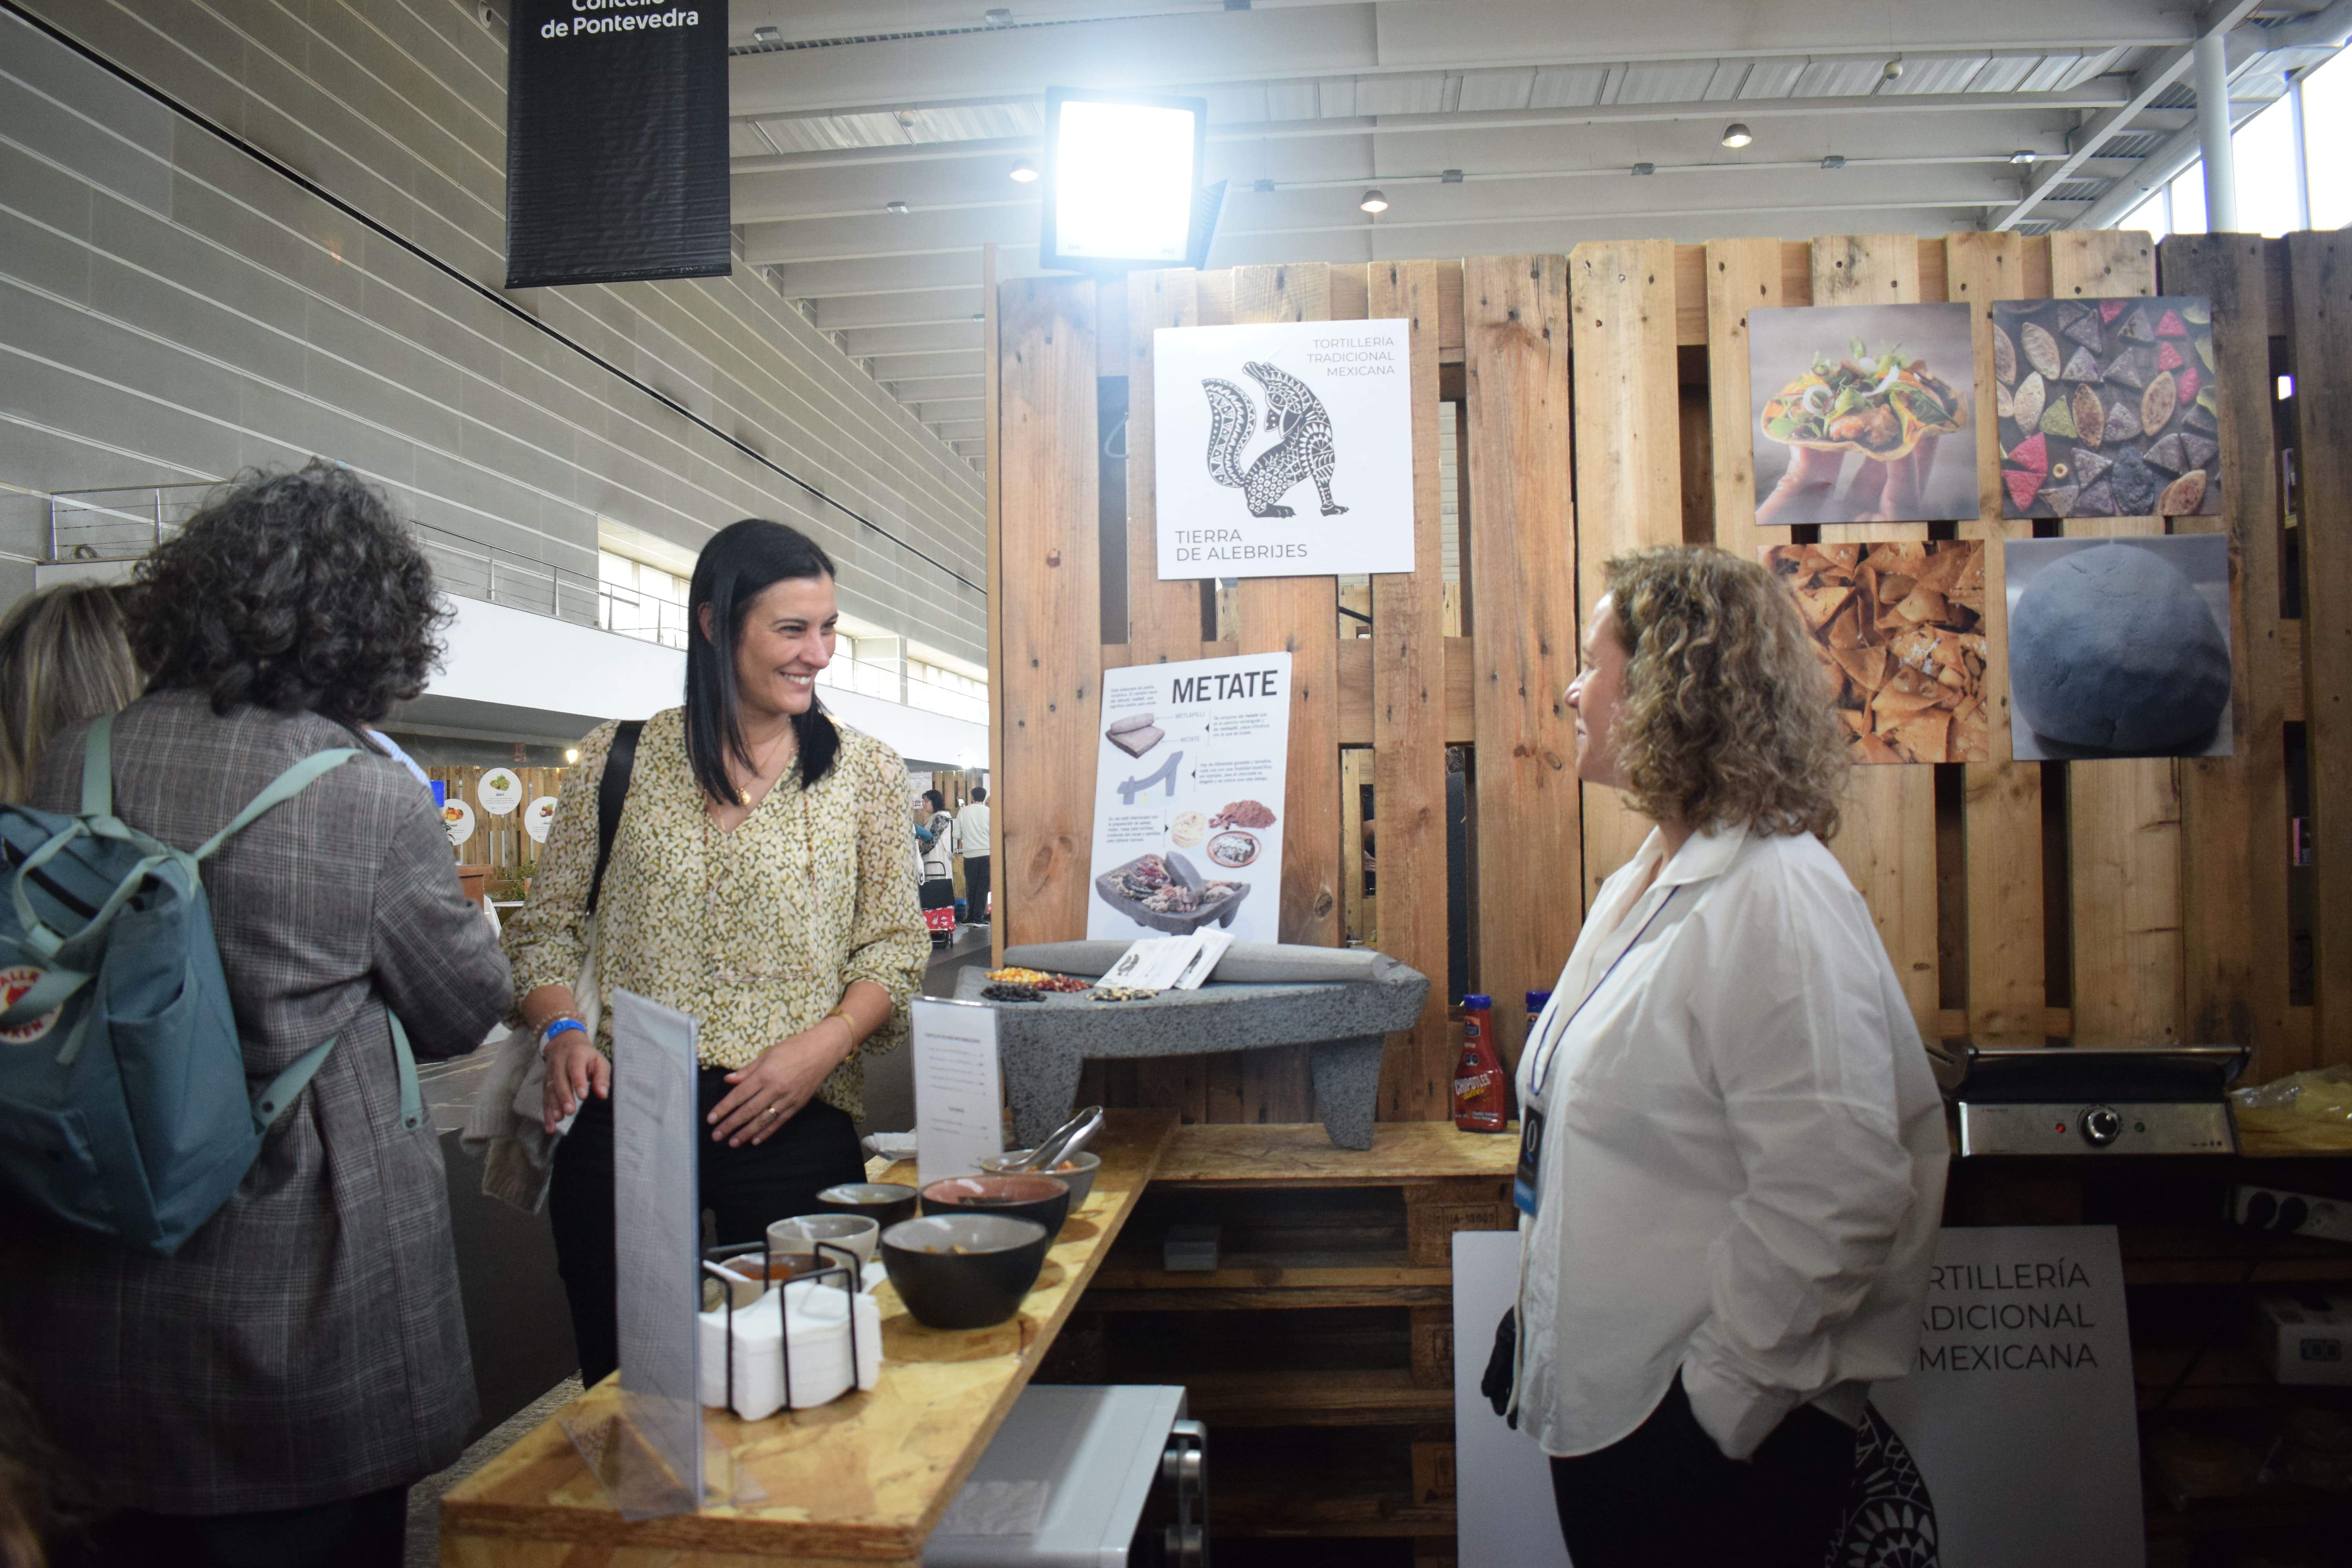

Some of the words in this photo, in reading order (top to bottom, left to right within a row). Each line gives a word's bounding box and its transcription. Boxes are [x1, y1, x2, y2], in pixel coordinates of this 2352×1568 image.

[572, 0, 665, 11] Conc
[541, 20, 568, 38] de
[573, 8, 699, 35] Pontevedra
[1313, 335, 1394, 348] TORTILLERÍA
[1307, 351, 1395, 363] TRADICIONAL
[1327, 365, 1395, 377] MEXICANA
[1176, 529, 1242, 544] TIERRA
[1176, 547, 1201, 561] DE
[1207, 544, 1307, 560] ALEBRIJES
[1172, 670, 1278, 704] METATE
[1930, 1257, 2090, 1290] RTILLERÍA
[1922, 1303, 2094, 1330] DICIONAL
[1920, 1343, 2098, 1371] MEXICANA
